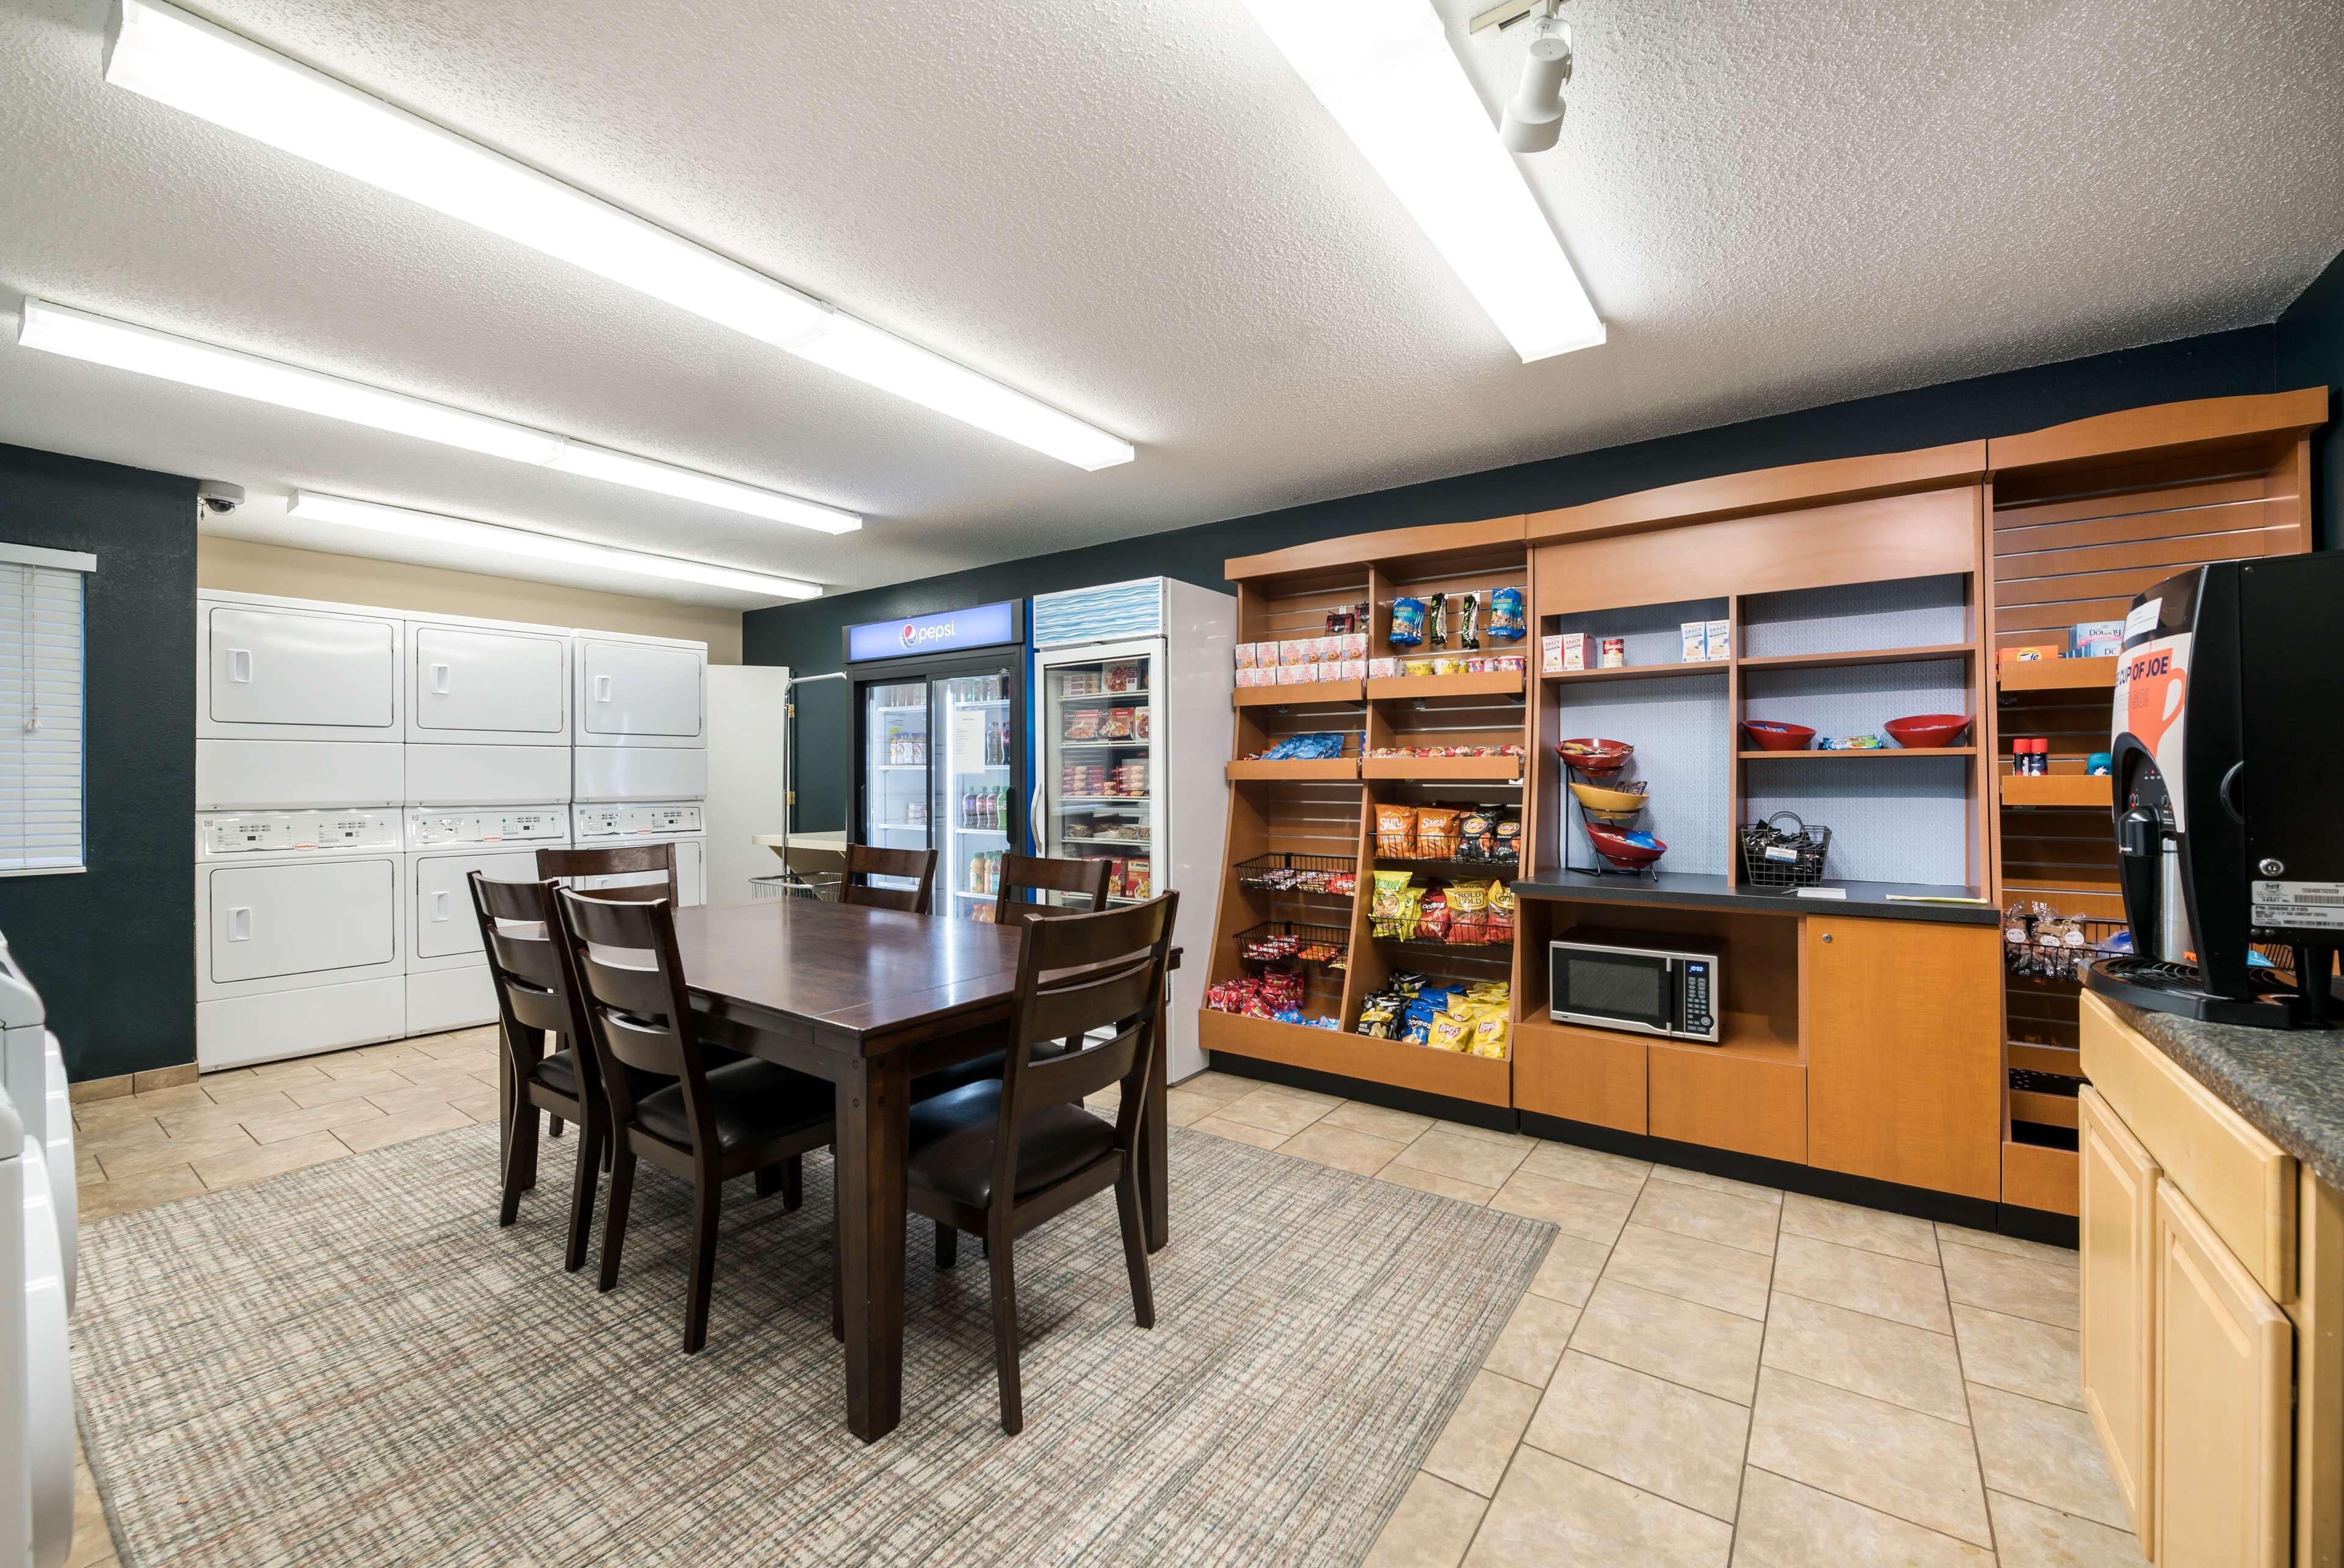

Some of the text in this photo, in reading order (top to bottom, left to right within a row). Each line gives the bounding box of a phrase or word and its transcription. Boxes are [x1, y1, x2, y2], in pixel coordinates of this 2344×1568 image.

[918, 620, 955, 644] pepsi
[2119, 666, 2132, 686] CUP
[2132, 661, 2145, 681] OF
[2146, 656, 2169, 678] JOE
[1407, 1019, 1432, 1029] Doritos
